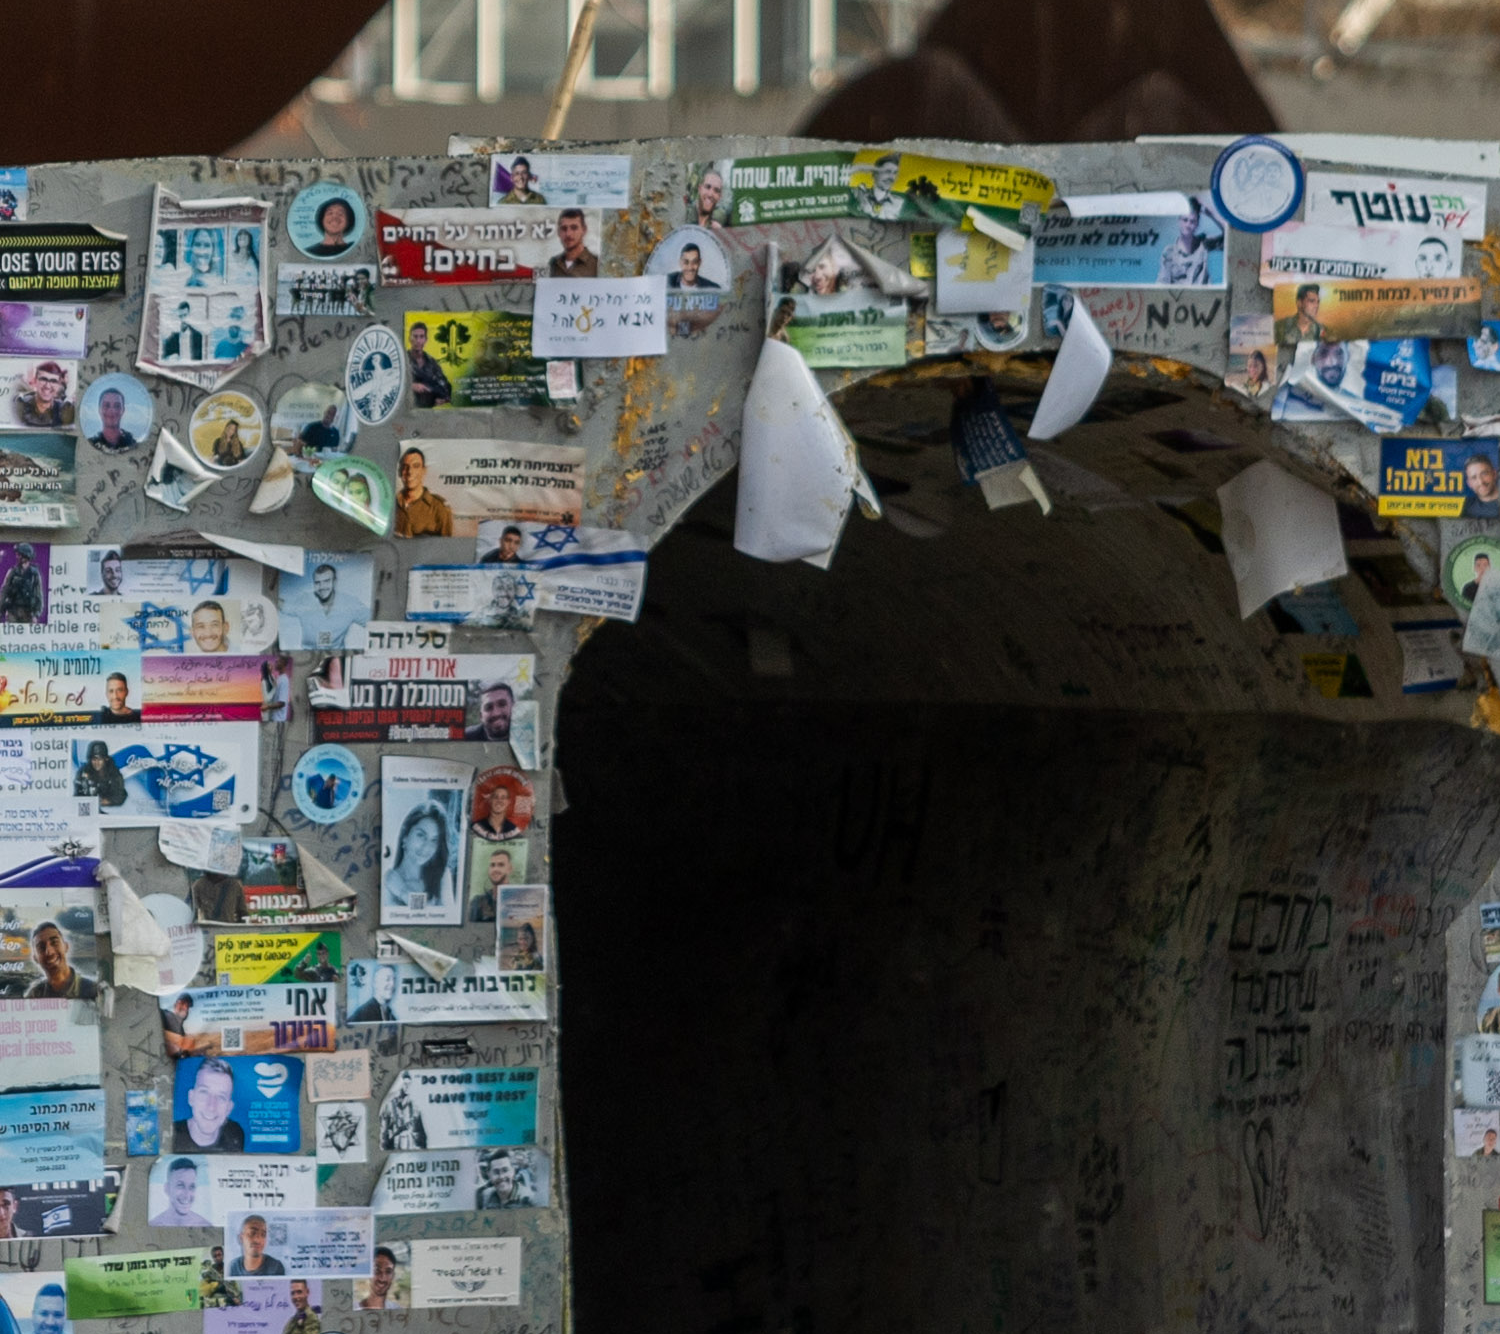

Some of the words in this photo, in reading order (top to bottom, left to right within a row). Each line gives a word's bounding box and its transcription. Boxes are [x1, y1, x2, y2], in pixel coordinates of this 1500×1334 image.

[383, 226, 439, 243] החיים
[444, 222, 469, 241] על
[474, 223, 527, 242] לוותר
[531, 220, 556, 241] לא
[34, 252, 76, 272] YOUR
[82, 251, 121, 271] EYES
[423, 245, 516, 273] בחיים!
[1146, 298, 1222, 329] NOW
[1380, 372, 1417, 388] ברמן
[1406, 448, 1444, 470] בוא
[509, 475, 529, 487] ולא
[530, 476, 575, 490] ההליכה
[368, 626, 447, 649] סליחה
[35, 659, 59, 678] עליך
[63, 658, 101, 676] נלחמים
[388, 658, 422, 678] דנינו
[425, 658, 456, 678] אורי
[44, 680, 58, 704] כל
[65, 687, 87, 707] עם
[352, 684, 374, 707] בע
[381, 682, 399, 707] לו
[402, 682, 466, 707] תסתכלו
[0, 738, 23, 747] גיבור
[402, 976, 458, 995] אהבה
[286, 988, 327, 1016] אחי
[24, 1019, 58, 1037] prone
[269, 1020, 328, 1049] הגיבור
[24, 1039, 77, 1055] distress.
[440, 1073, 473, 1085] YOUR
[29, 1104, 68, 1116] תכתוב
[72, 1102, 96, 1114] אתה
[10, 1121, 50, 1136] הסיפור
[52, 1120, 71, 1134] את
[387, 1177, 425, 1192] נחמן!
[428, 1175, 455, 1187] תהיו
[243, 1192, 285, 1208] לחייך
